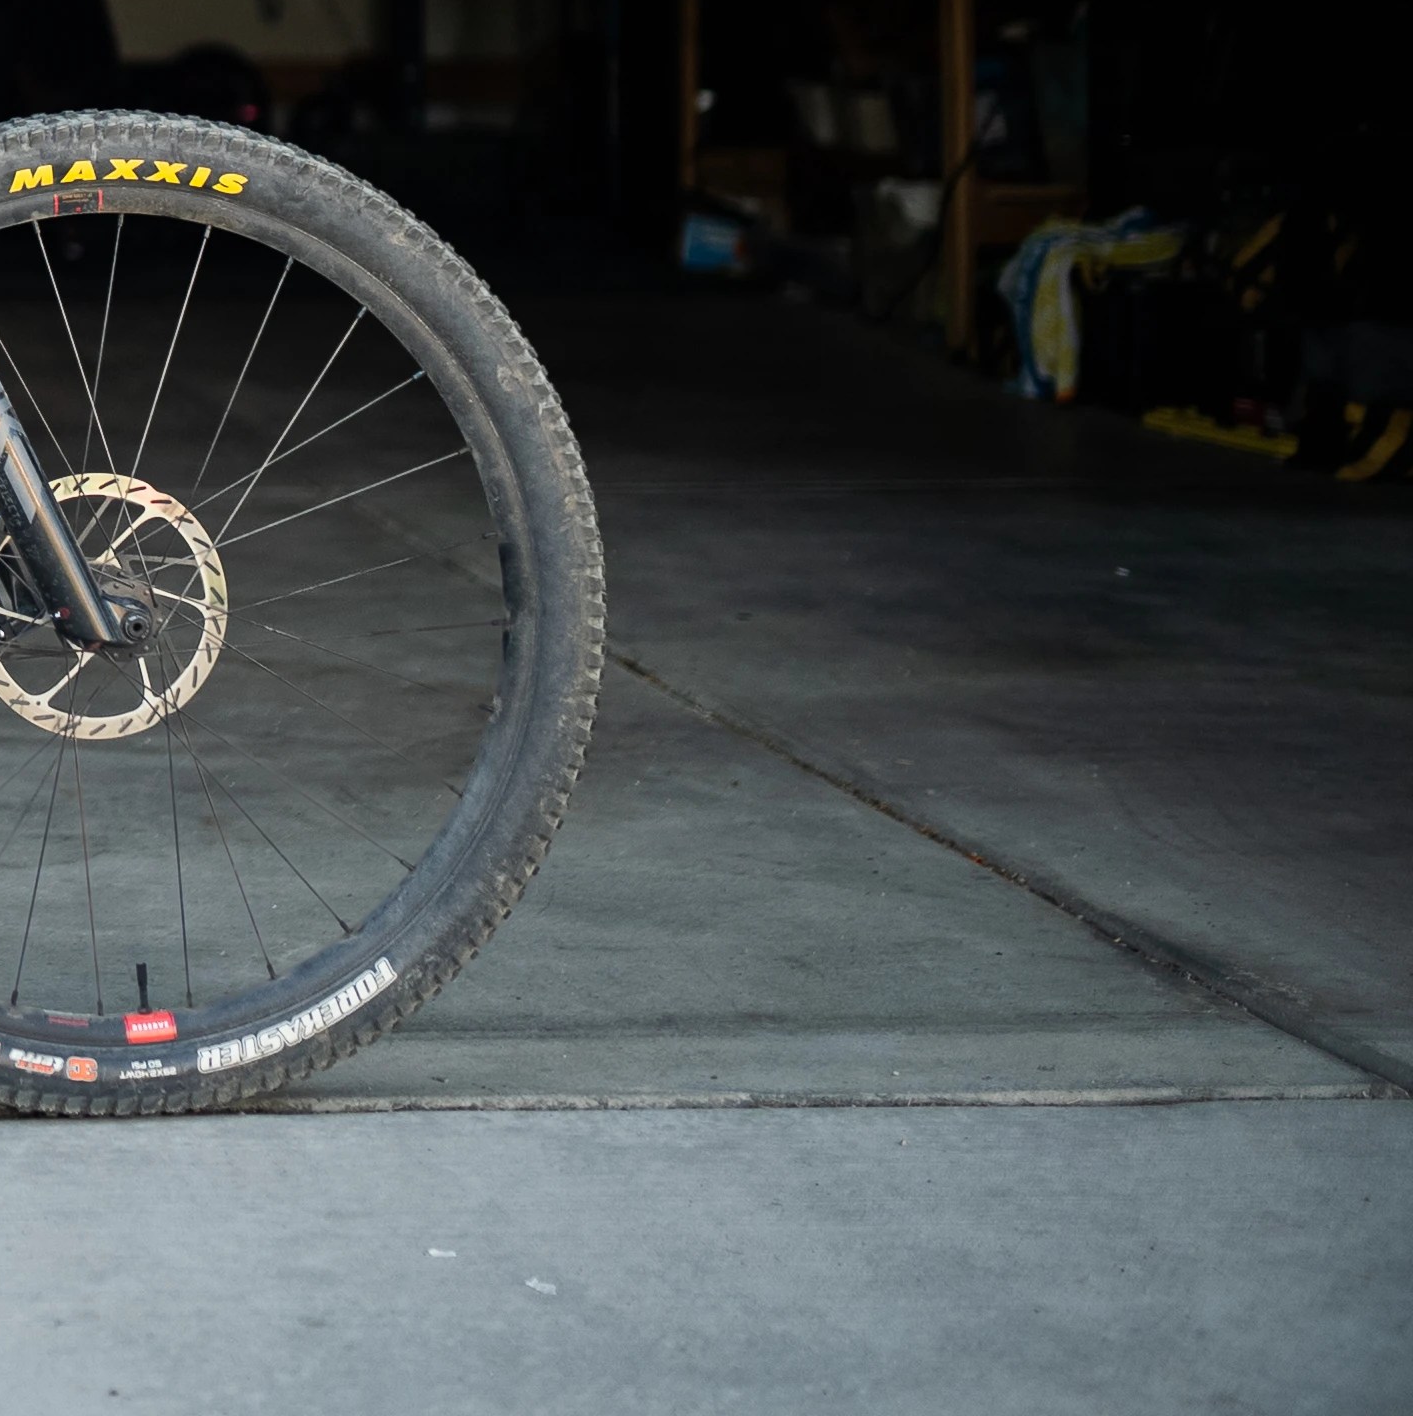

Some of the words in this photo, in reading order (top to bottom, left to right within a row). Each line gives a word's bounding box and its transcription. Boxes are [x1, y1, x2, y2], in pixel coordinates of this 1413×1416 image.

[9, 159, 249, 195] MAXXIS
[130, 1020, 170, 1032] RESERVE
[197, 956, 397, 1074] FOREKASTER
[130, 1060, 147, 1070] PSI
